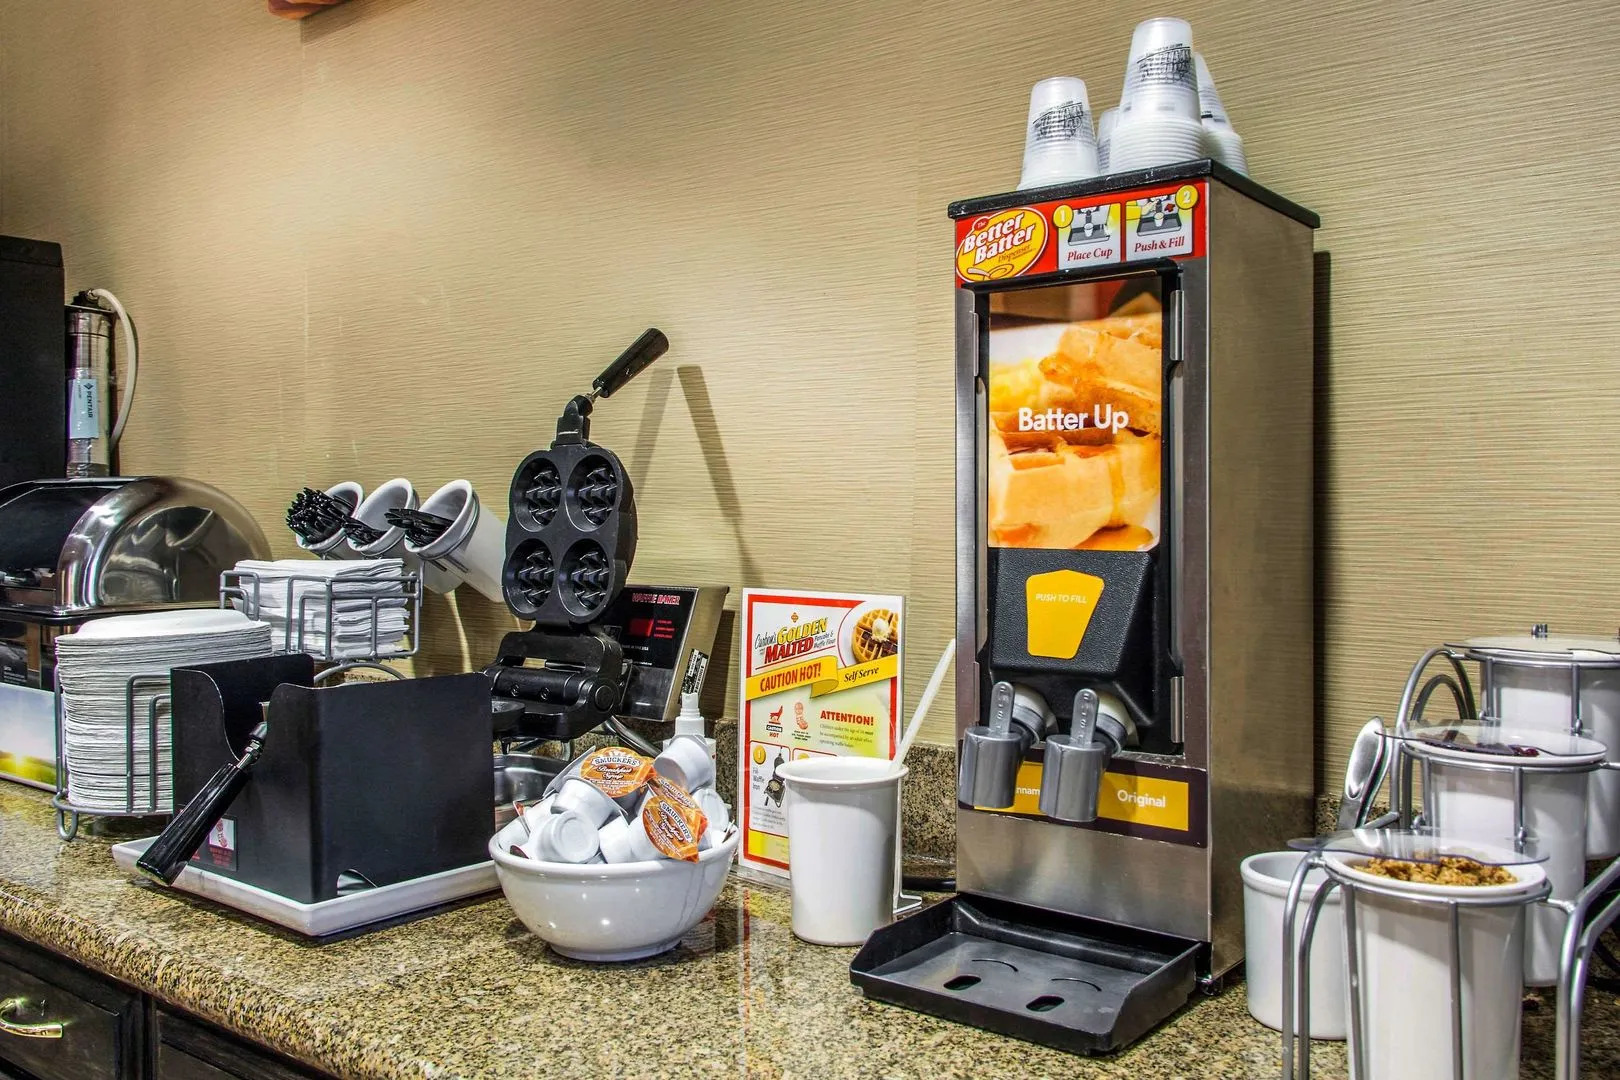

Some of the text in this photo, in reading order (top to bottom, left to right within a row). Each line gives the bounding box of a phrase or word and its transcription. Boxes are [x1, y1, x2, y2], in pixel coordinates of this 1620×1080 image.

[1183, 191, 1191, 203] 2
[962, 212, 1025, 255] Better
[1134, 236, 1185, 252] Push & Fill
[973, 223, 1036, 266] Batter
[1067, 247, 1113, 261] Place Cup
[1018, 404, 1130, 434] Batter Up
[1035, 593, 1087, 604] PUSH TO FILL
[777, 617, 828, 645] GOLDEN
[764, 637, 814, 664] MALTED
[760, 662, 821, 692] CAUTION HOT!
[843, 666, 879, 683] Self Serve
[820, 710, 874, 726] ATTENTION!
[1015, 787, 1166, 808] nnam Original
